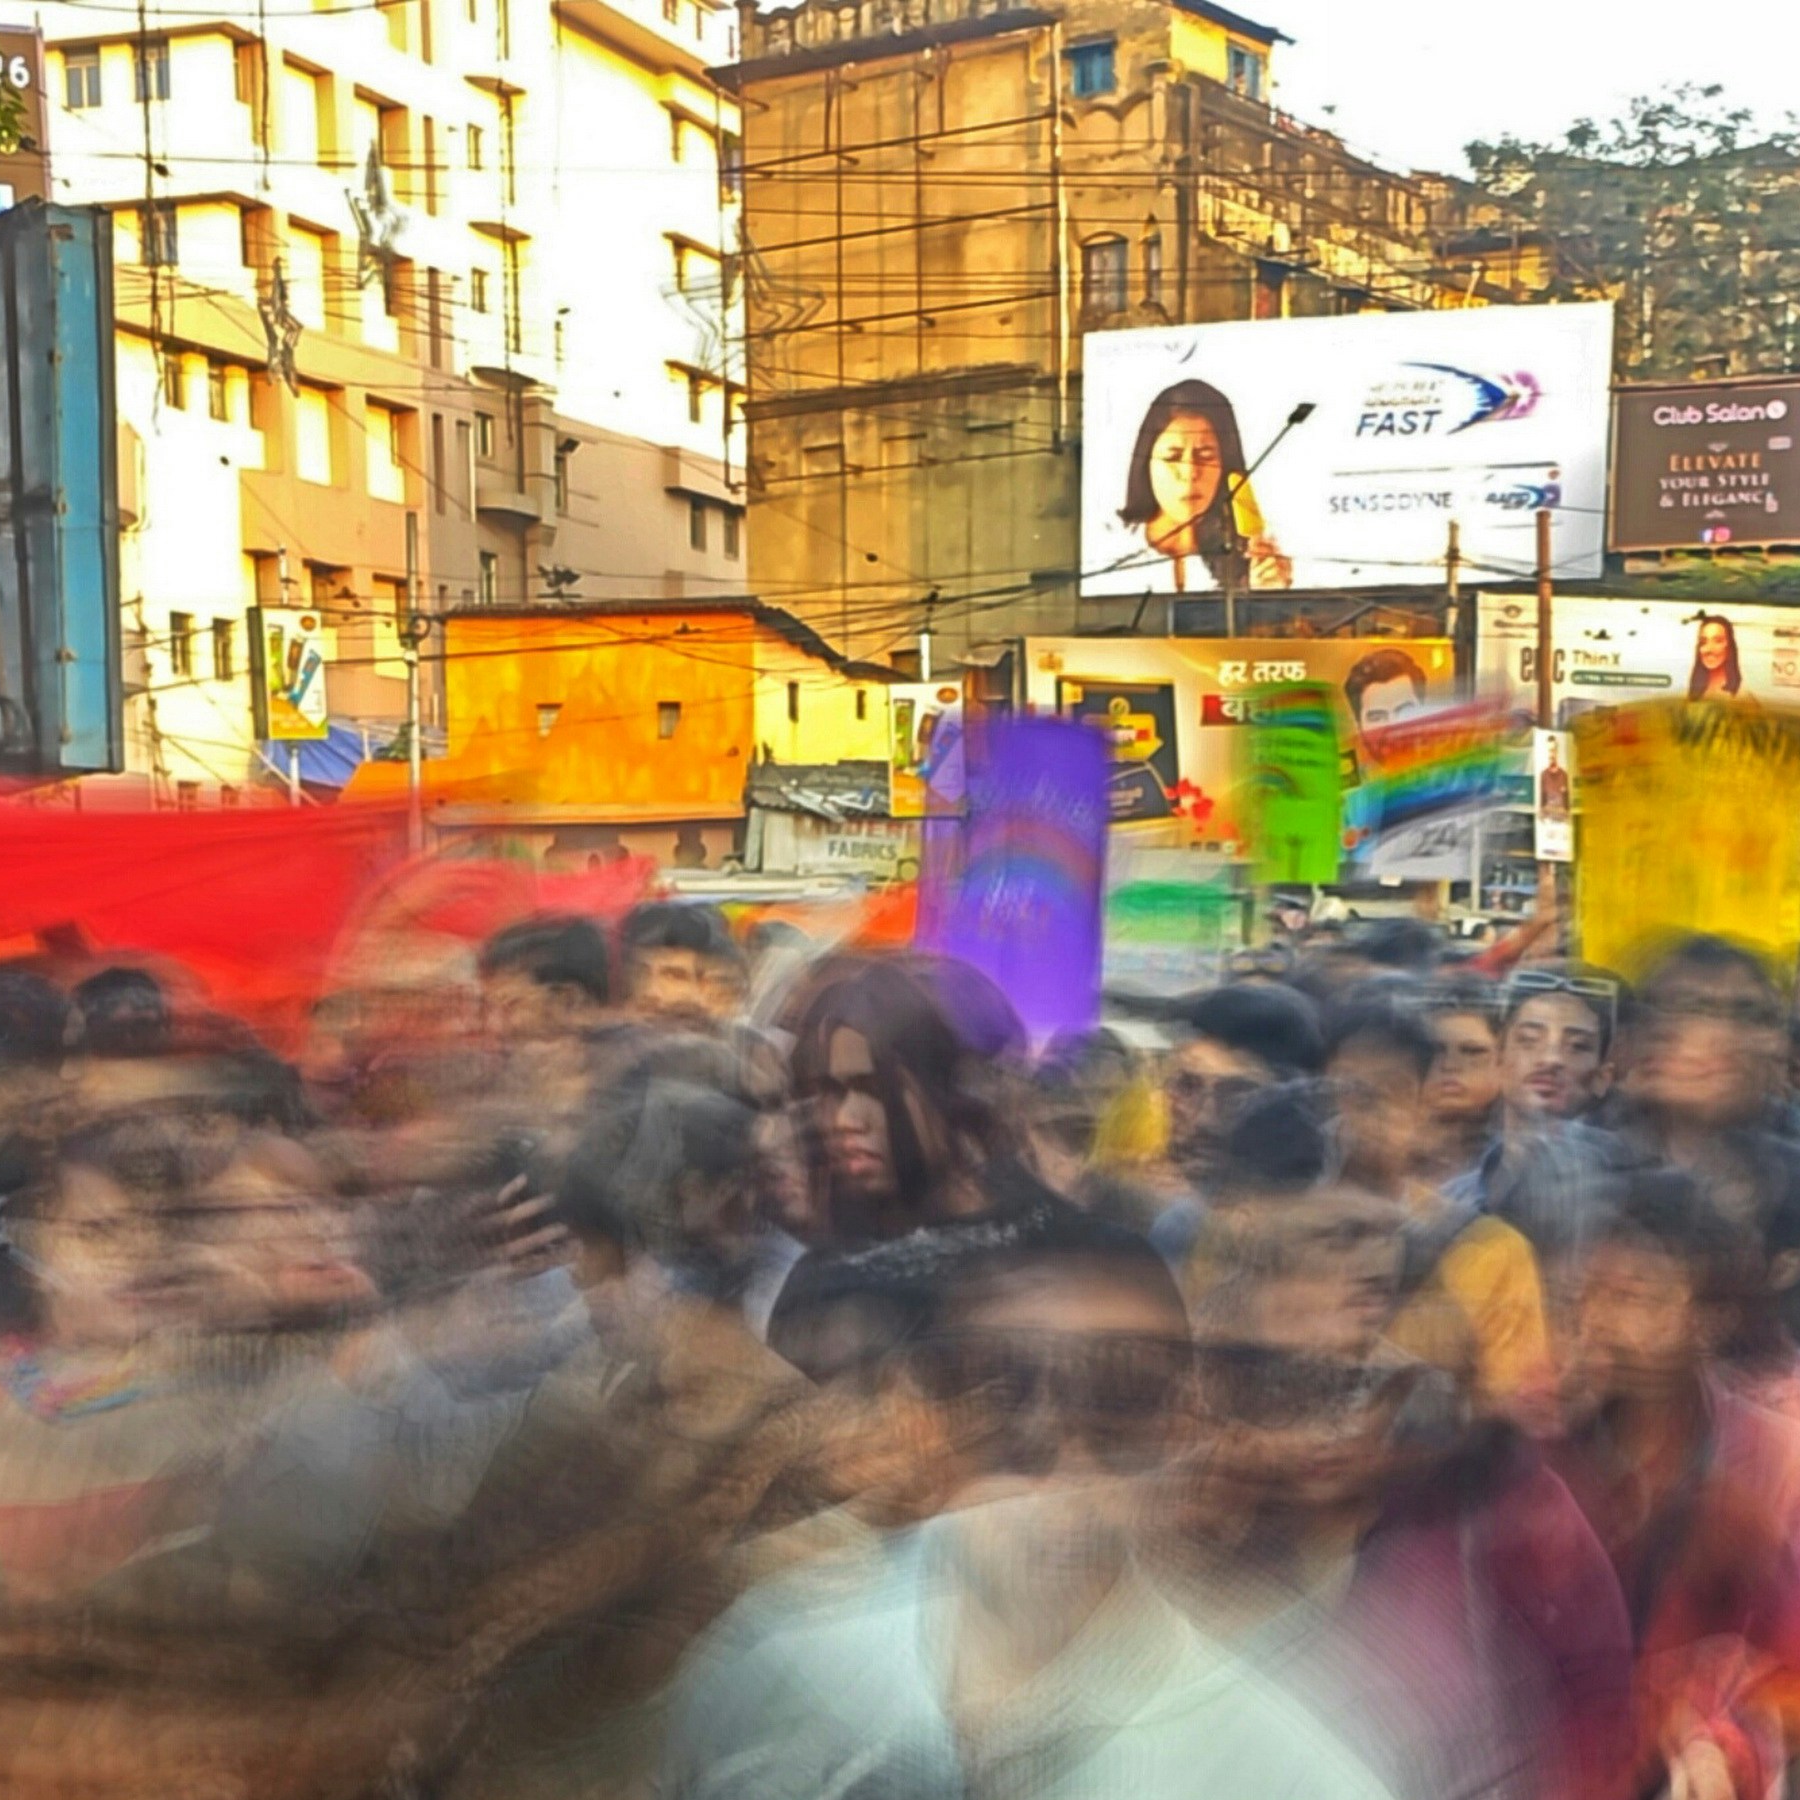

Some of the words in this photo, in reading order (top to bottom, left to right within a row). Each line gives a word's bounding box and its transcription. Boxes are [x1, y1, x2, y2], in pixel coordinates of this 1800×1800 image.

[1355, 409, 1443, 437] FAST
[1653, 405, 1703, 425] Club
[1705, 402, 1765, 423] Salon
[1669, 452, 1762, 472] ELEVATE
[1659, 475, 1710, 490] YOUR
[1717, 472, 1769, 487] STYLE
[1329, 491, 1453, 514] SENSODYNE
[1218, 660, 1247, 686] हर
[1253, 660, 1306, 683] तरफ
[828, 840, 898, 860] FABRICS
